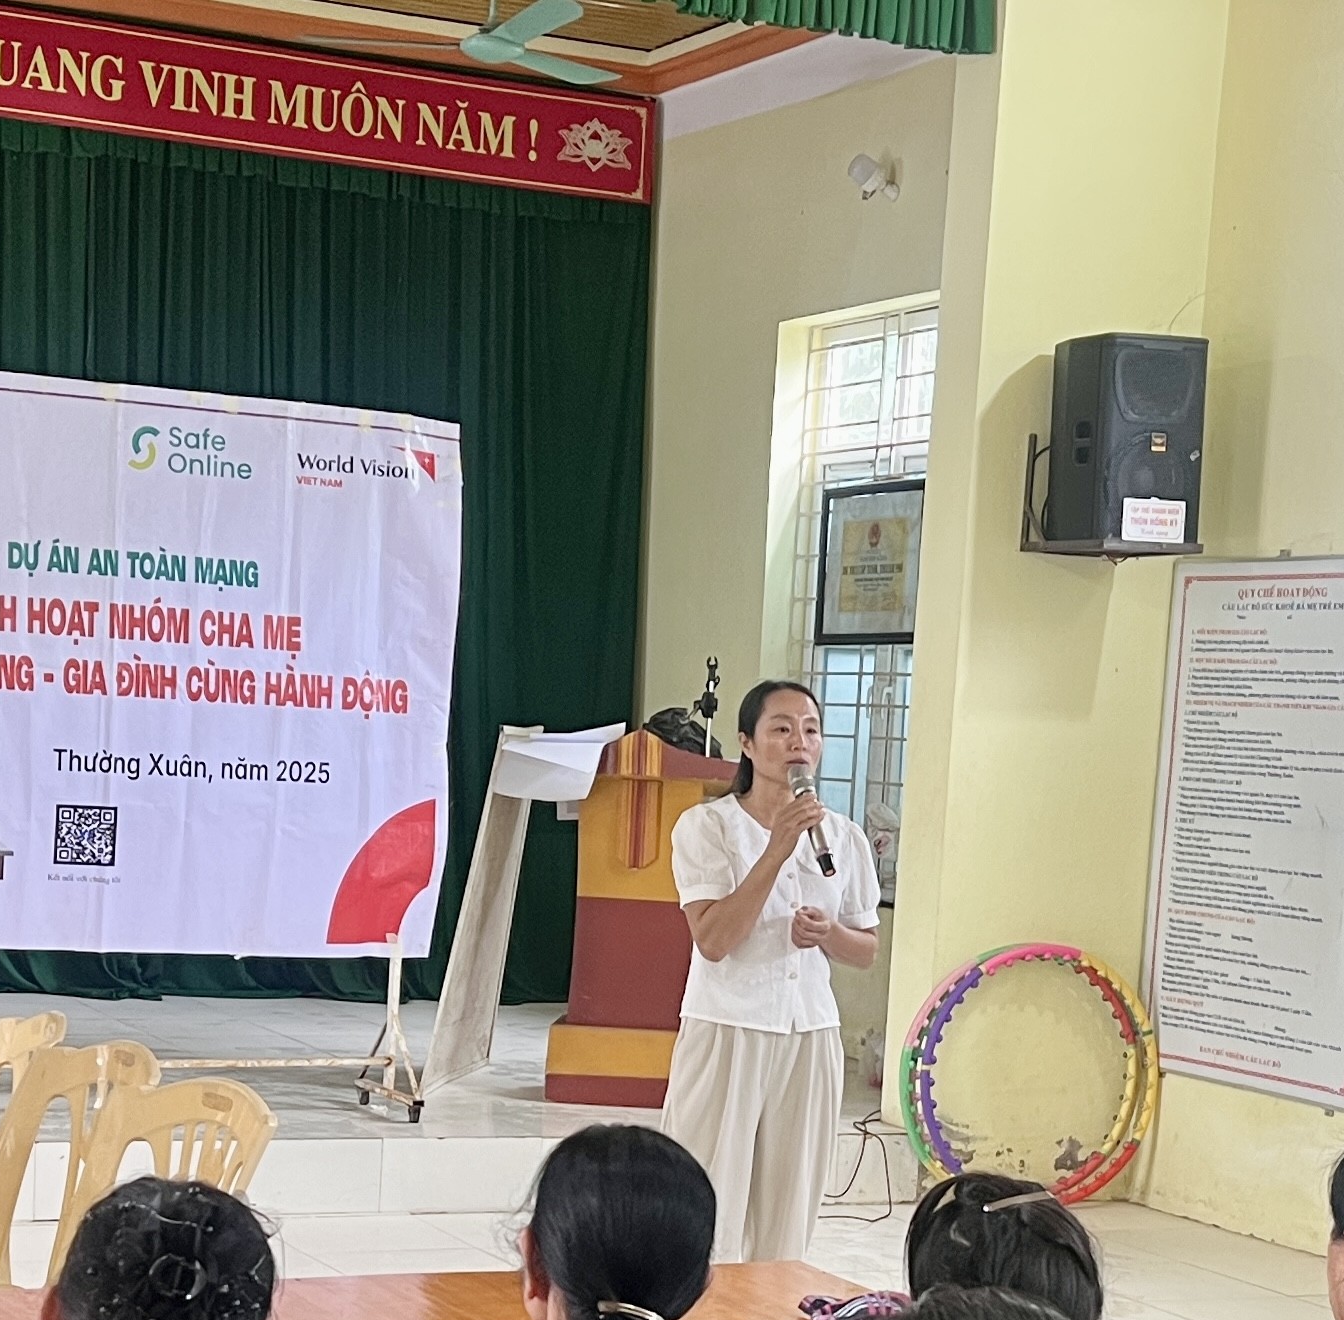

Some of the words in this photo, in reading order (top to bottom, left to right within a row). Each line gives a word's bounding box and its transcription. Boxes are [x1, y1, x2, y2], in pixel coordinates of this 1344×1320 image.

[138, 58, 256, 122] VINH
[267, 80, 405, 142] MUÔN
[416, 99, 516, 160] NĂM
[527, 119, 540, 162] !
[168, 425, 226, 452] Safe
[167, 453, 253, 480] Online
[296, 453, 355, 475] World
[296, 475, 318, 488] VIET
[320, 477, 343, 489] NAM
[7, 540, 41, 577] DỰ
[47, 538, 79, 574] ÁN
[87, 548, 119, 577] AN
[126, 546, 187, 583] TOÀN
[194, 556, 259, 592] MẠNG
[27, 596, 100, 646] HOẠT
[109, 596, 190, 645] NHÓM
[199, 609, 254, 649] CHA
[263, 614, 302, 660] MẸ
[63, 657, 108, 696] GIA
[116, 653, 177, 700] ĐÌNH
[185, 658, 256, 705] CÙNG
[264, 663, 334, 710] HÀNH
[341, 669, 408, 720] ĐỘNG
[53, 748, 141, 781] Thường
[148, 753, 214, 784] Xuân,
[221, 756, 269, 781] năm
[275, 759, 331, 784] 2025
